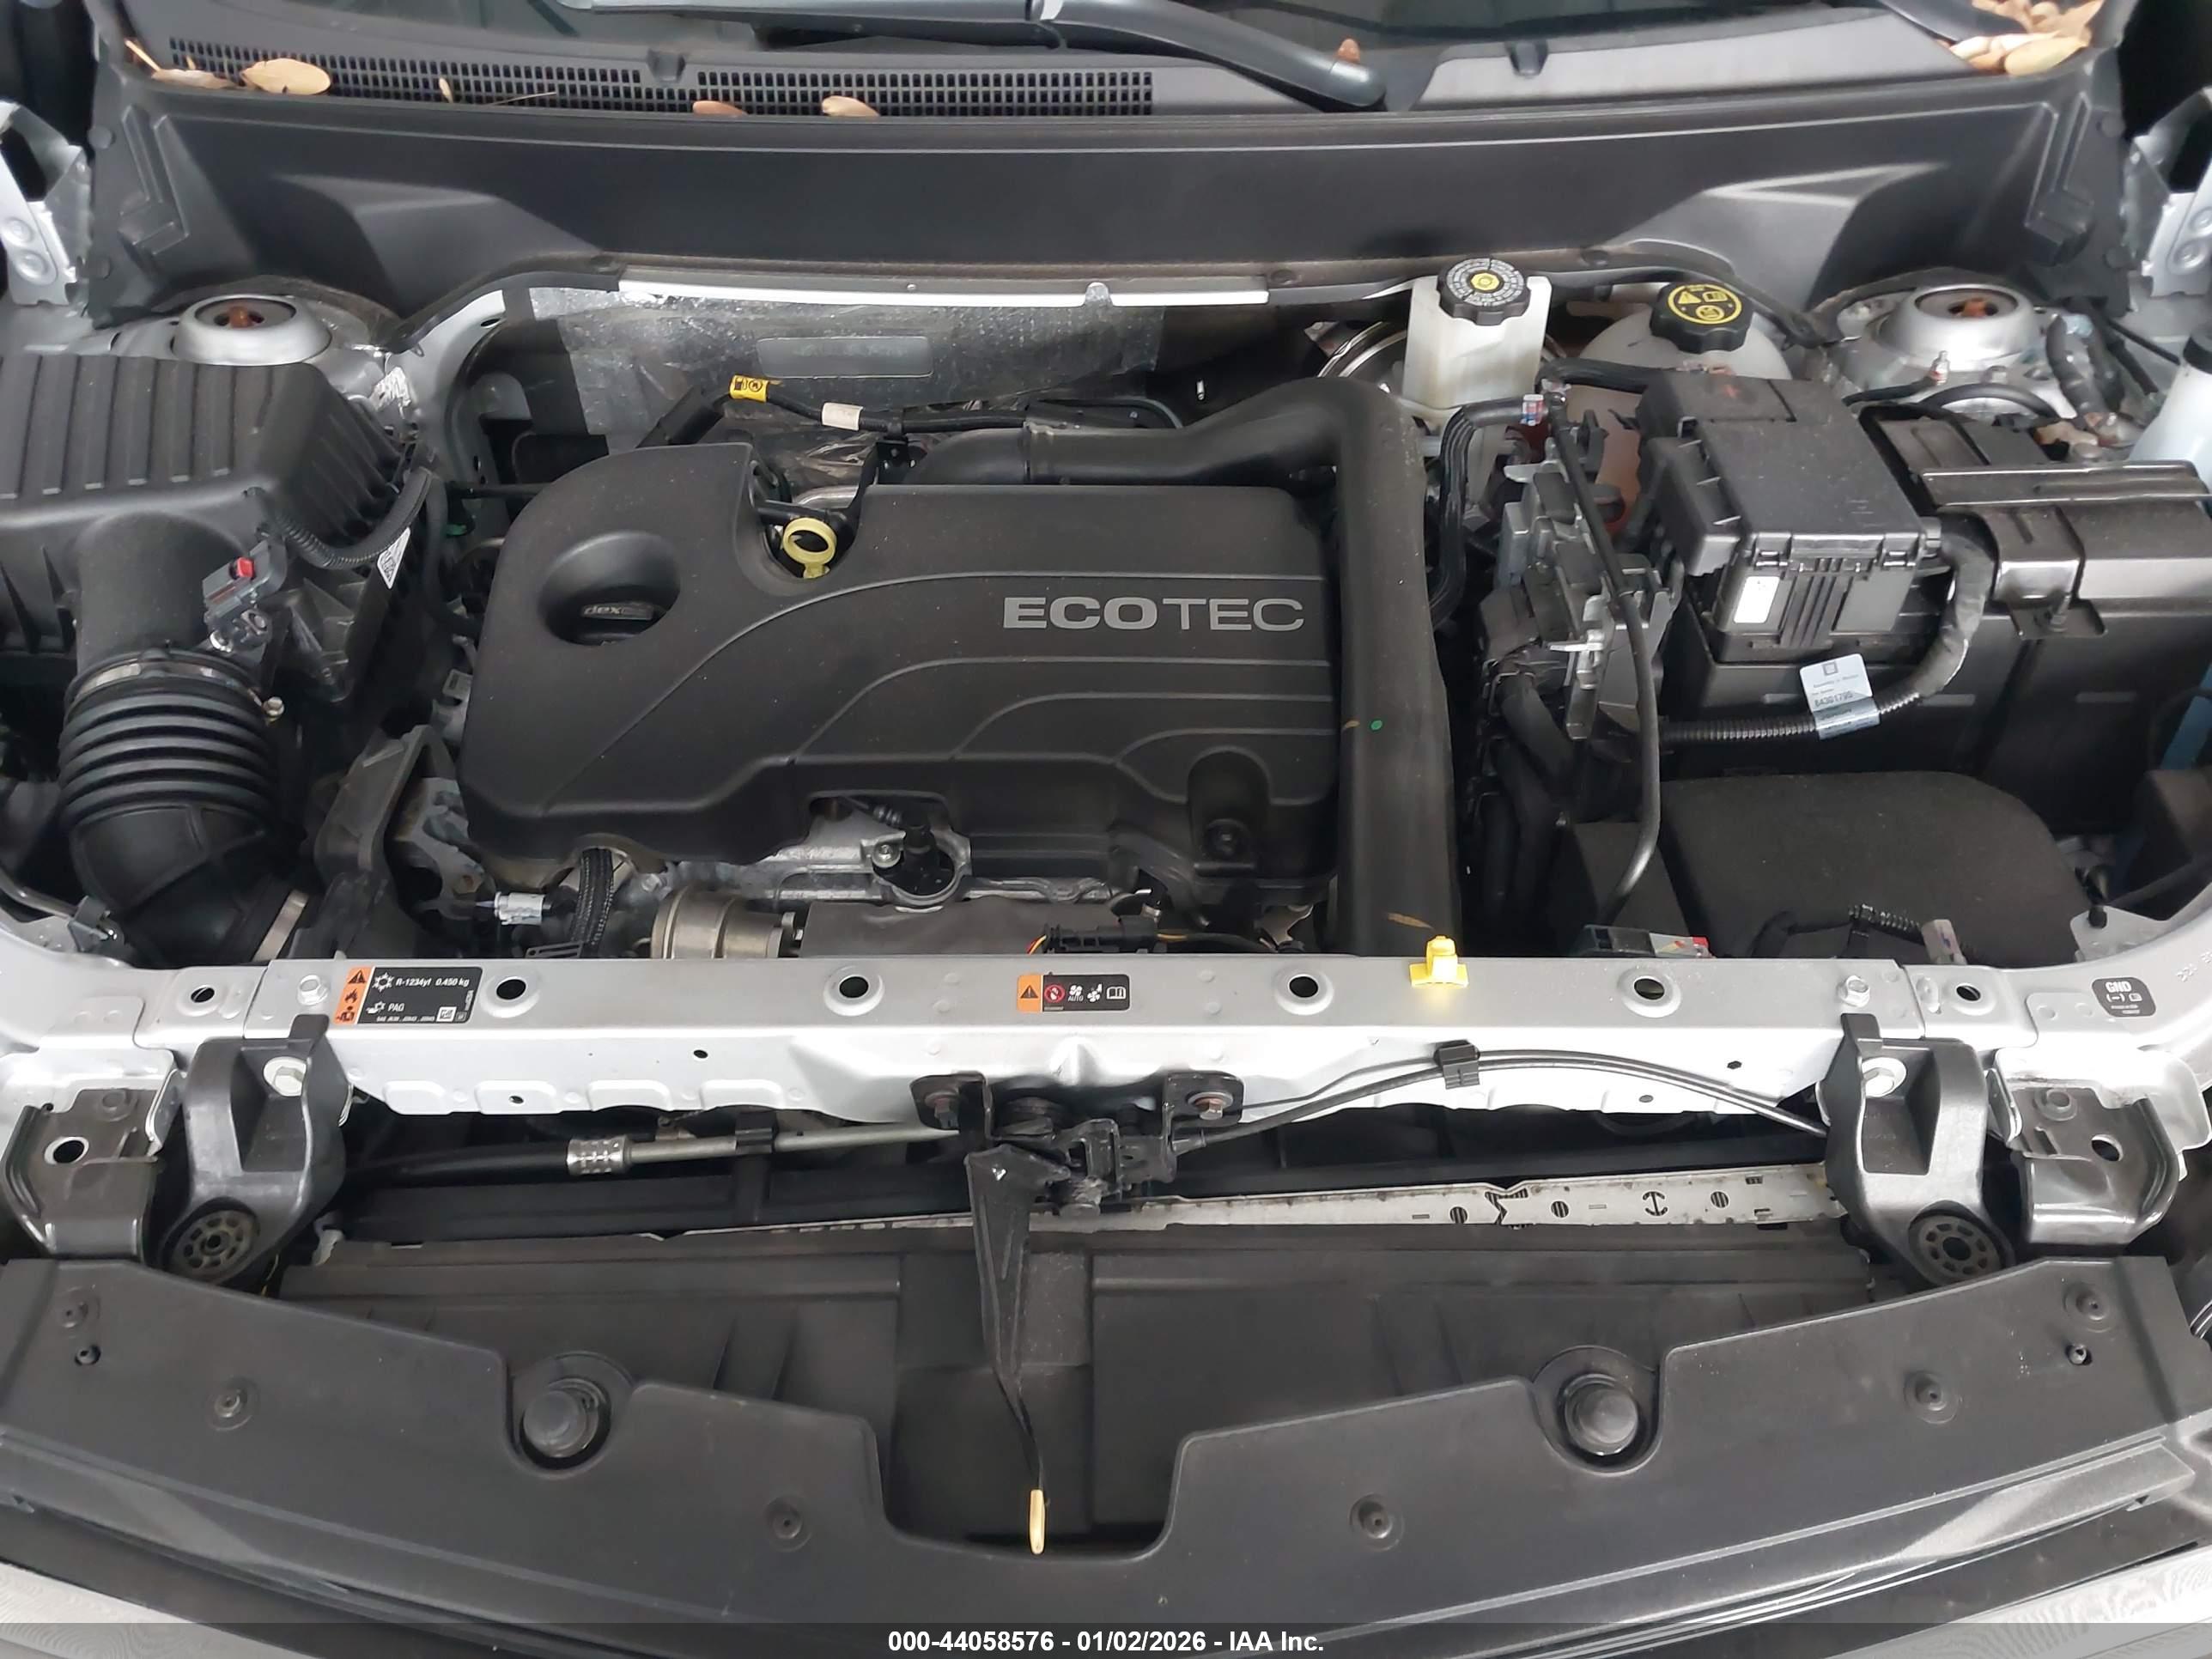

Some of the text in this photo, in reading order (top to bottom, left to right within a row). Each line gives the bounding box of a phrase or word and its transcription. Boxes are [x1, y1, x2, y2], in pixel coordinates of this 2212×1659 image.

[1003, 596, 1304, 631] ECOTEC
[395, 977, 470, 988] R-1234yf 0.450 kg
[2105, 981, 2132, 993] GND
